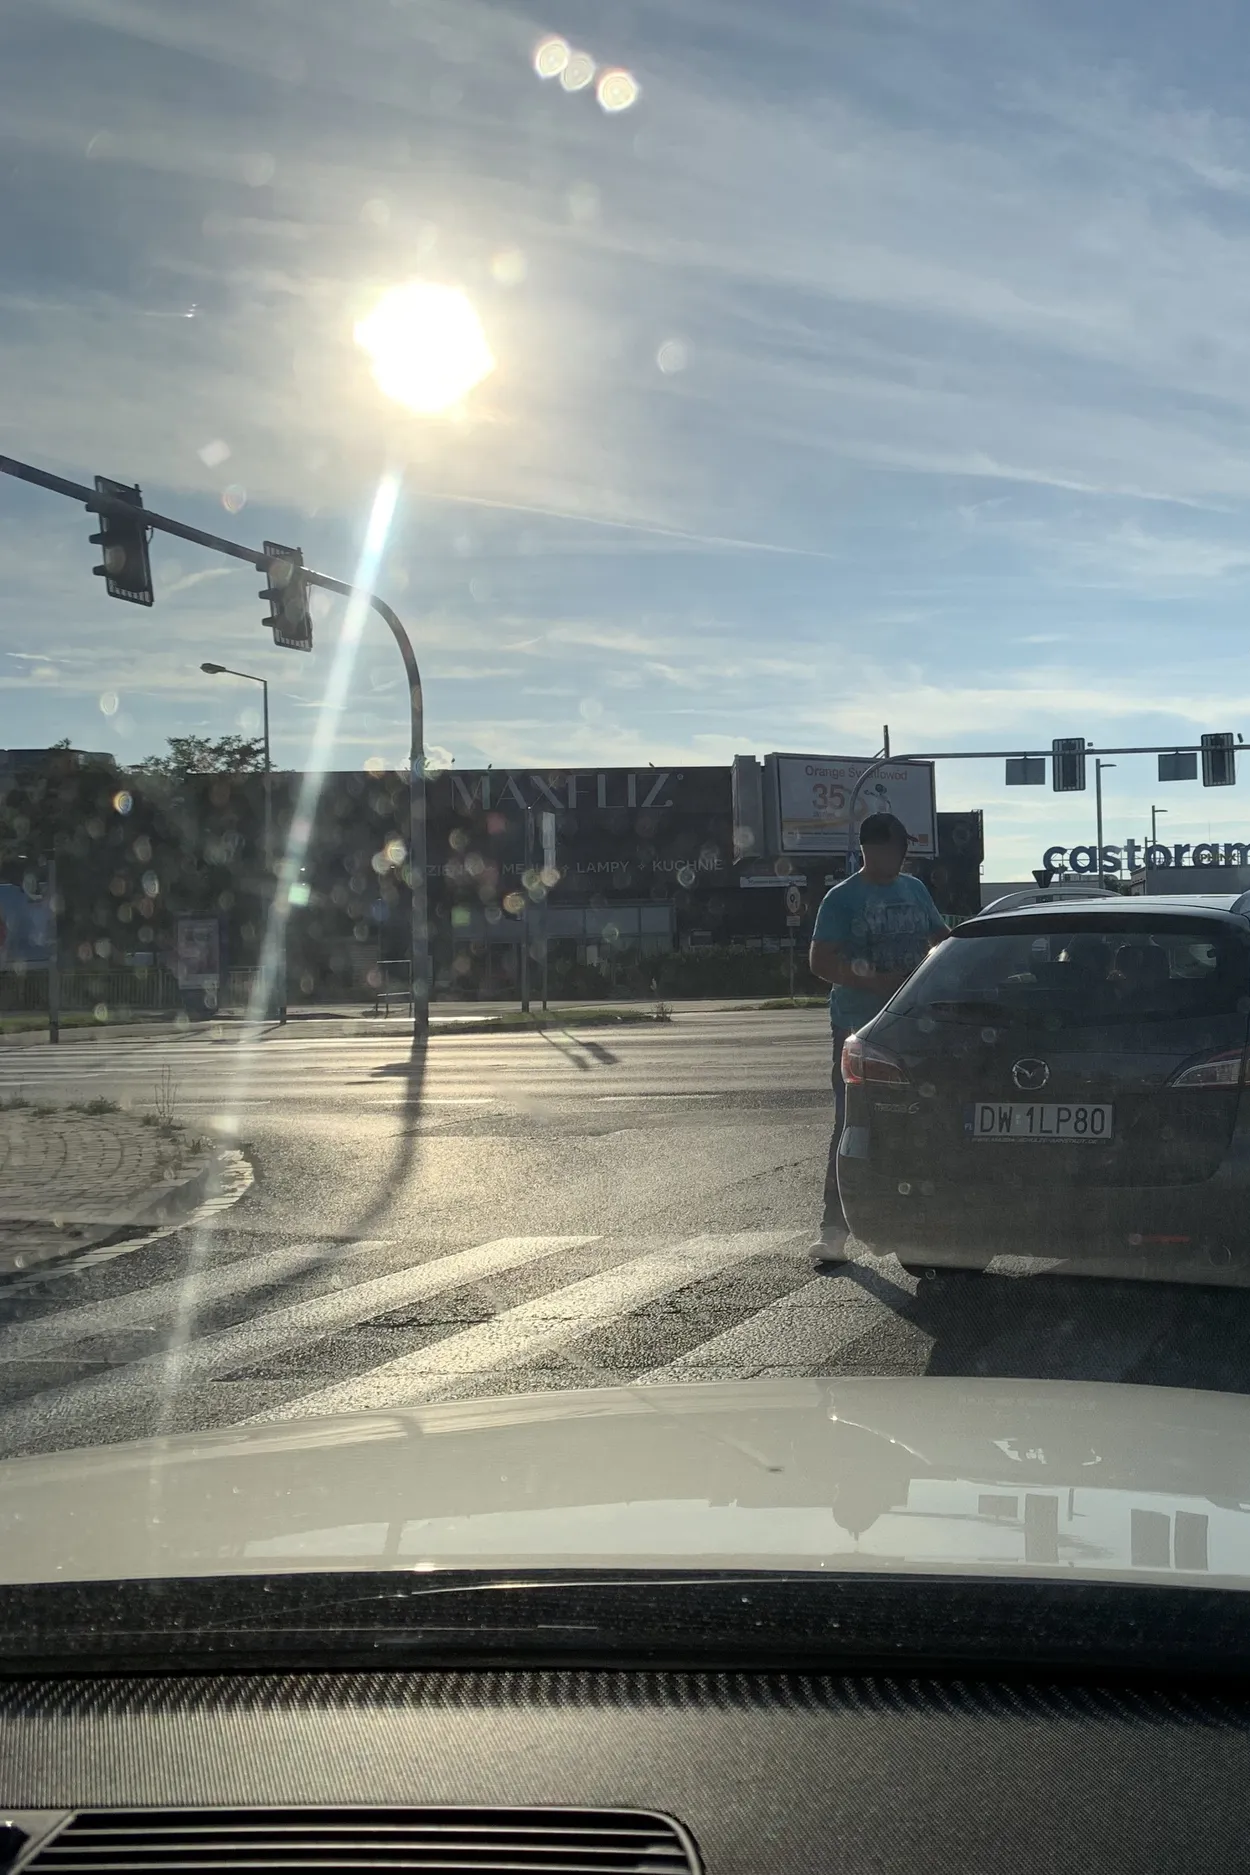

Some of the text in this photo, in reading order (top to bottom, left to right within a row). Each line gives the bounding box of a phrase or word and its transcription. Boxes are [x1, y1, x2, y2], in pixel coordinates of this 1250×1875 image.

[805, 765, 845, 780] Orange
[449, 772, 674, 811] MAXFLIZ
[812, 783, 845, 810] 35
[576, 861, 629, 874] LAMPY
[653, 859, 724, 873] KUCHNIE
[979, 1105, 1106, 1136] DW 1LP80
